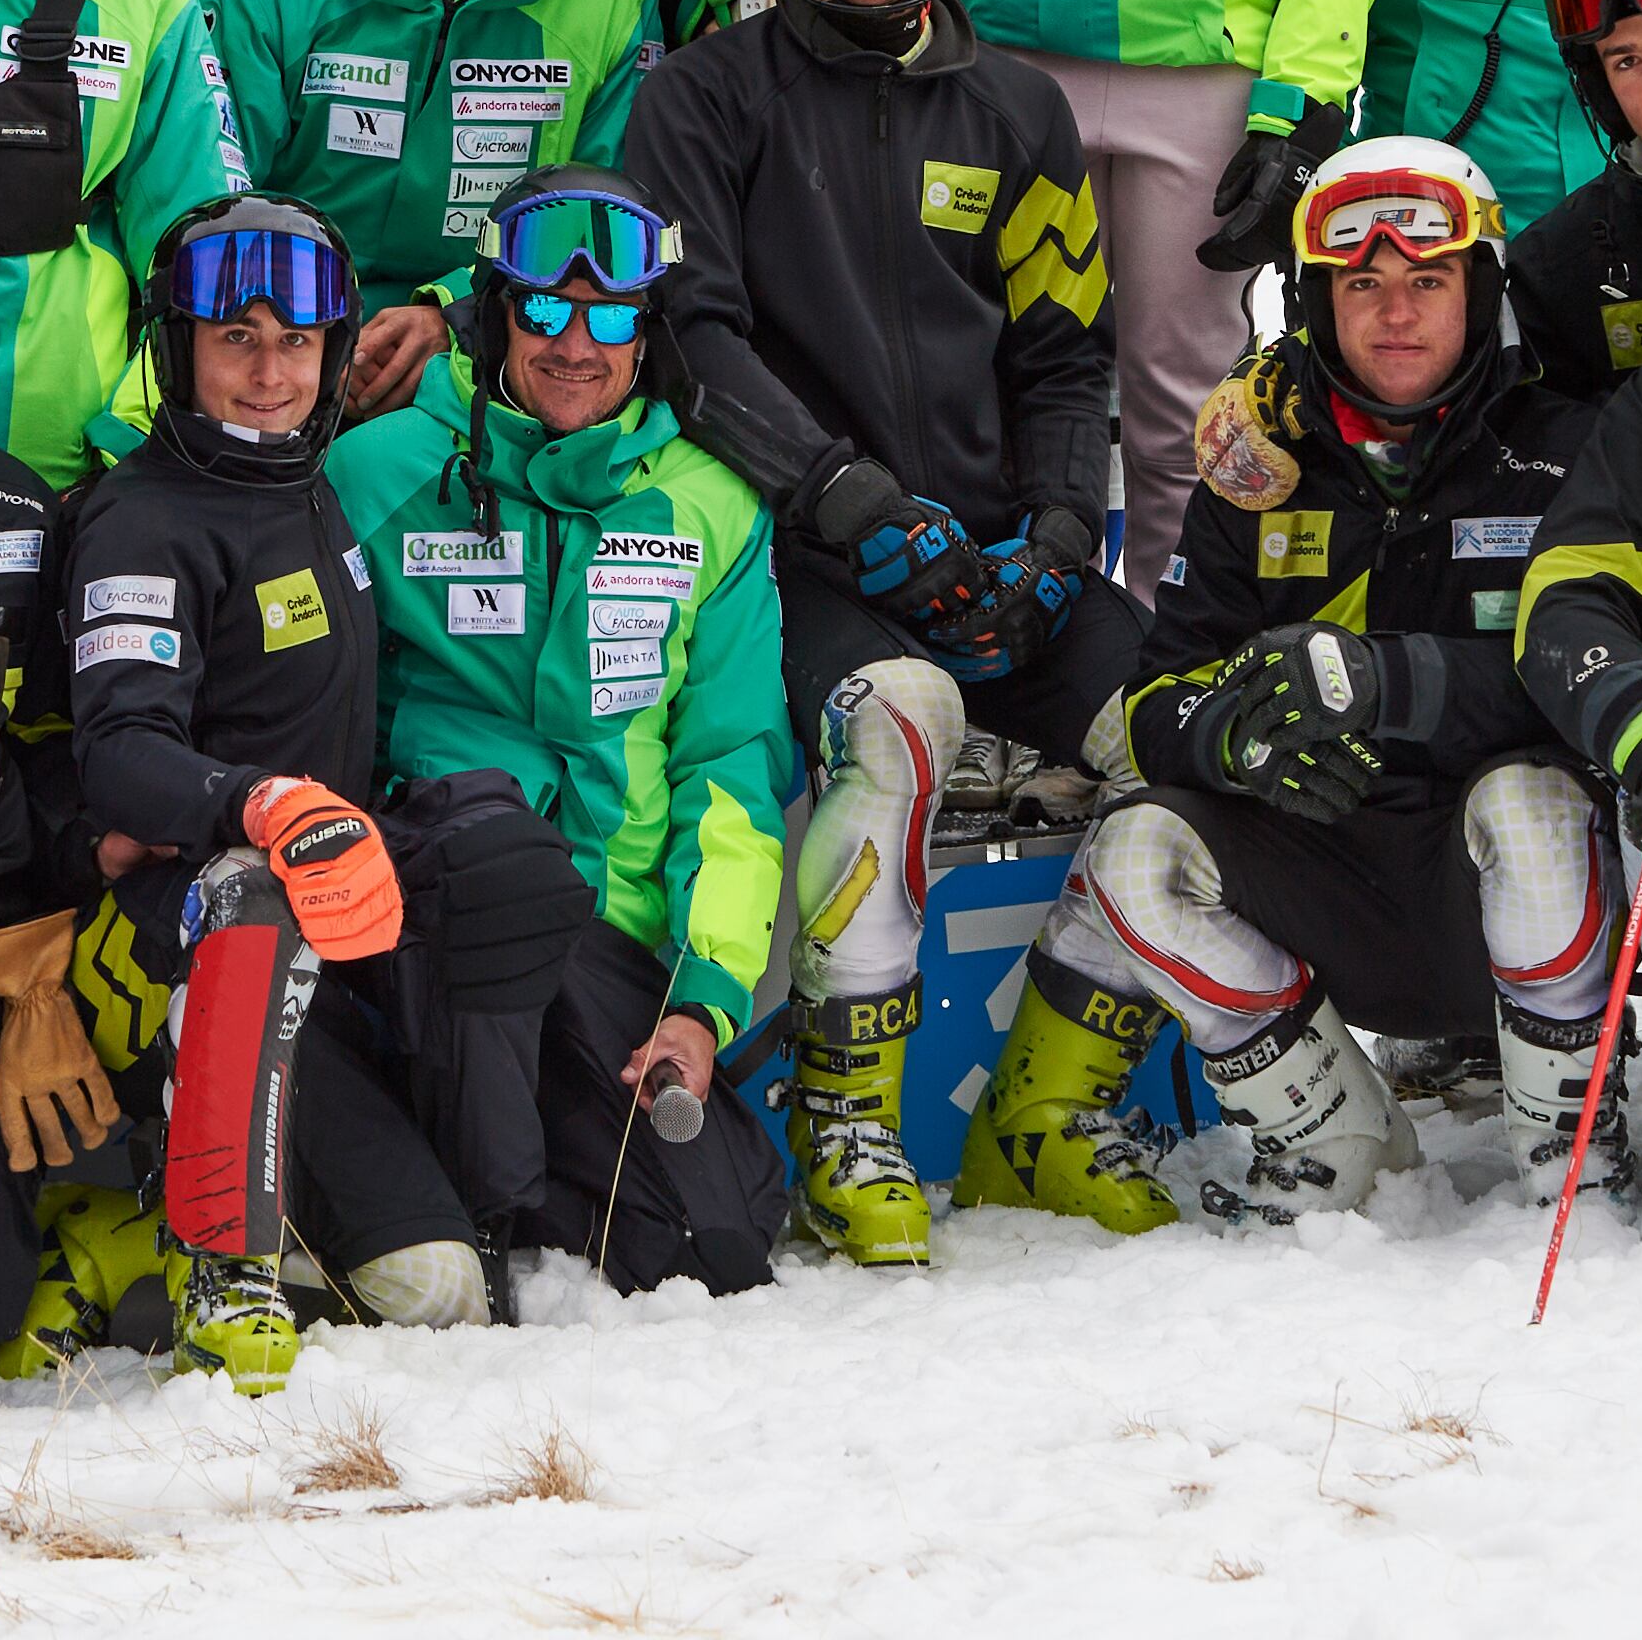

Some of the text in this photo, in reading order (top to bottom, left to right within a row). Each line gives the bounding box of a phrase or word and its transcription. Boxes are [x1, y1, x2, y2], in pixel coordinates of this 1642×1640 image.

[475, 101, 561, 111] andorra telecom
[479, 133, 507, 142] AUTO
[476, 142, 527, 153] FACTORIA
[954, 187, 989, 205] Crèdit
[1483, 528, 1530, 537] ANDORRA
[109, 581, 144, 592] AUTO
[611, 574, 691, 590] andorra telecom
[107, 591, 168, 607] FACTORIA
[287, 595, 313, 610] Crèdit
[291, 604, 323, 624] Andorrà
[615, 607, 644, 618] AUTO
[612, 617, 664, 631] FACTORIA
[77, 633, 143, 660] caldea
[1217, 646, 1255, 687] LEKI
[1318, 639, 1346, 702] LEKI
[616, 687, 660, 703] ALTAVISTA
[1340, 732, 1382, 769] LEKI
[288, 818, 363, 860] reusch
[299, 886, 352, 908] racing
[850, 996, 919, 1041] RC4
[1082, 988, 1158, 1040] RC4
[1283, 1090, 1348, 1145] HEAD
[265, 1070, 282, 1195] ENERGIAPURA
